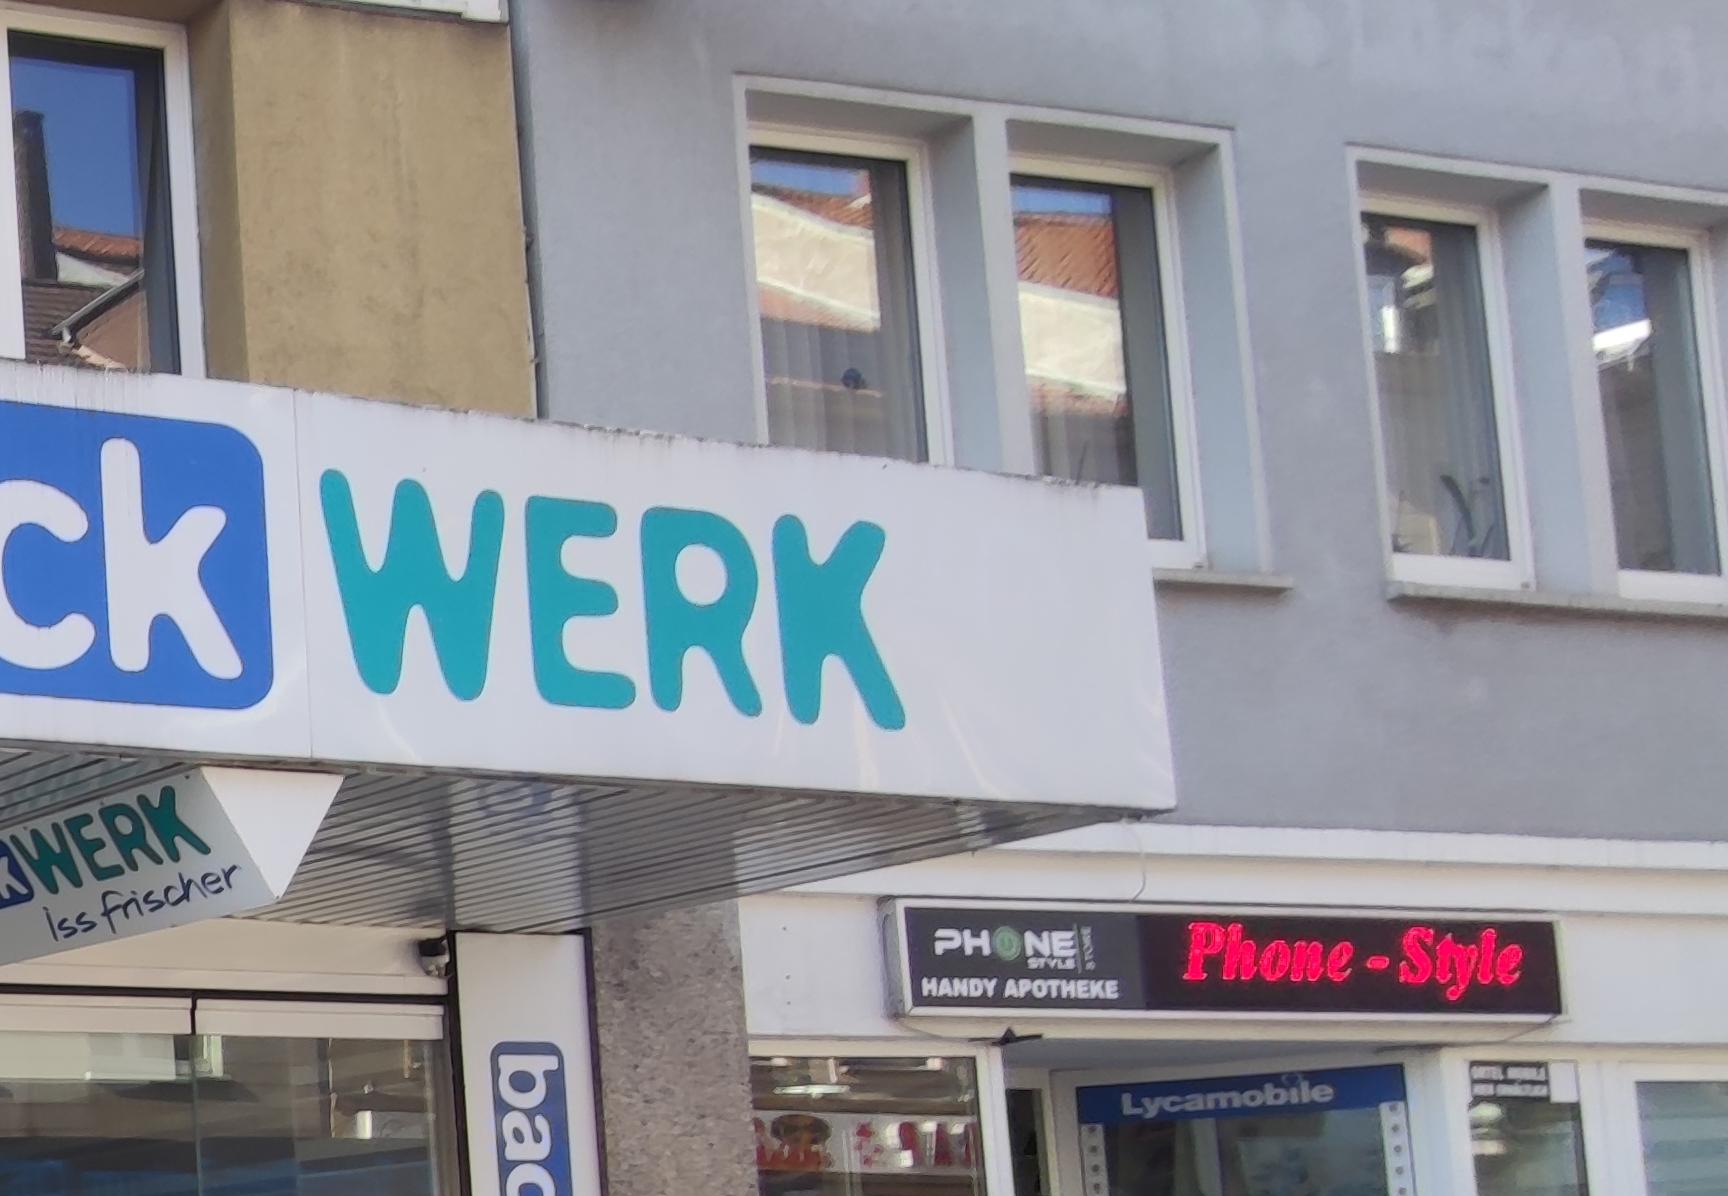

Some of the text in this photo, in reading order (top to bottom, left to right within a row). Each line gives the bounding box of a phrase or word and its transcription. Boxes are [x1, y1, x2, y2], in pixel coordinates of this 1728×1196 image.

[319, 467, 909, 732] WERK
[9, 785, 212, 895] WERK
[100, 864, 241, 935] frischer
[921, 976, 1120, 1000] HANDY APOTHEKE
[1027, 957, 1076, 971] STYLE
[1182, 921, 1355, 982] Phone
[1398, 925, 1524, 1001] Style
[1121, 1080, 1335, 1119] Lycamobile
